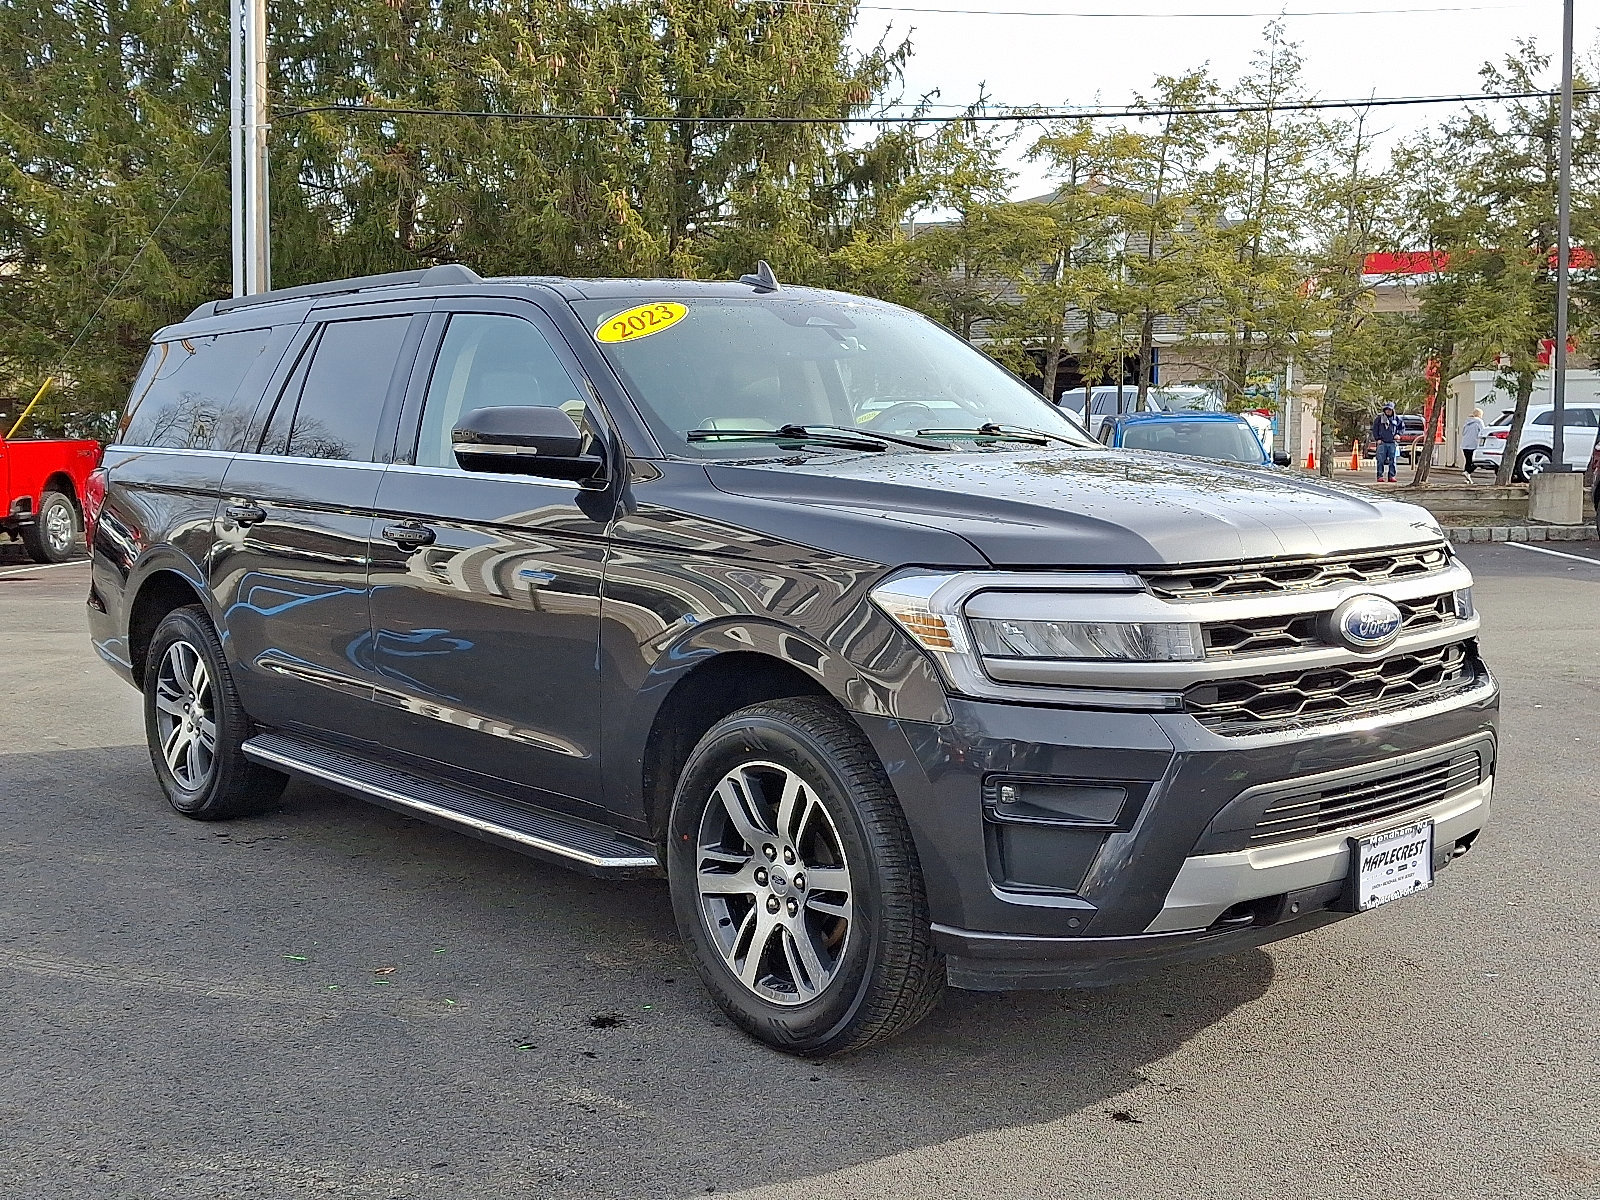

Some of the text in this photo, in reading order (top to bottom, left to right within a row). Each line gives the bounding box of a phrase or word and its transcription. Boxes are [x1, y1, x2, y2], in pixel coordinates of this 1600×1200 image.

[613, 306, 674, 338] 2023
[1359, 610, 1393, 637] Ford
[1362, 839, 1427, 873] MAPLECREST
